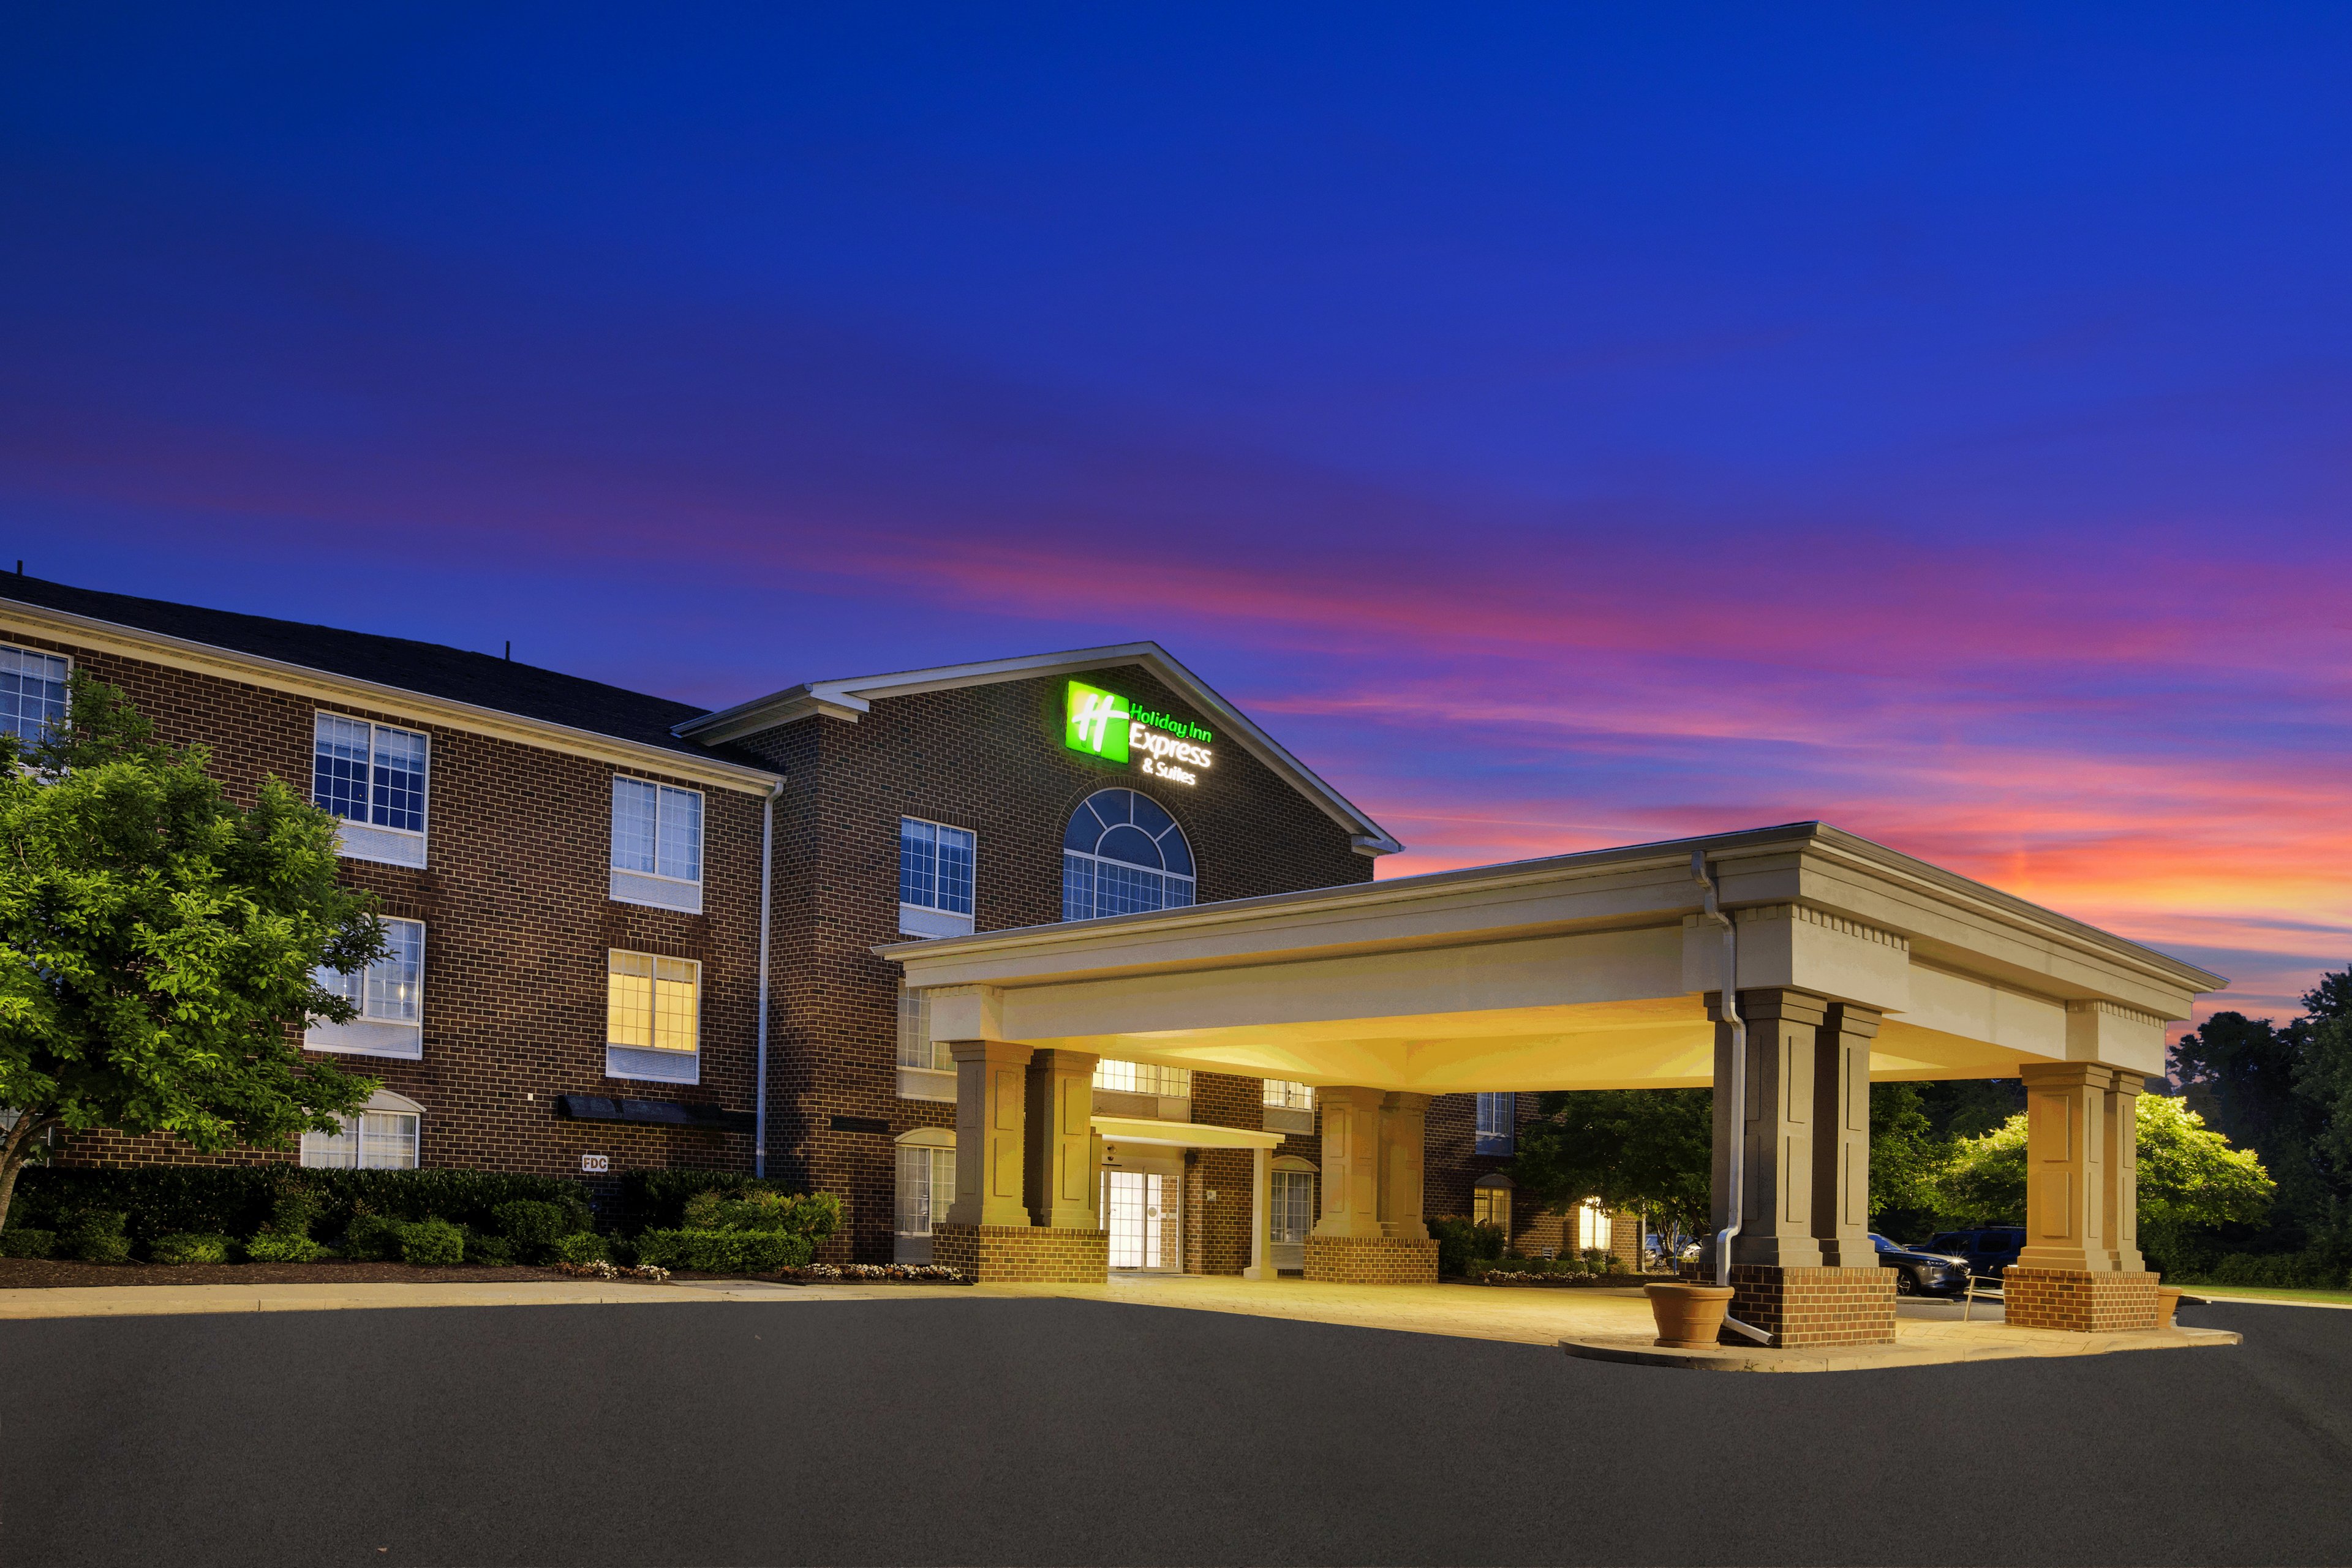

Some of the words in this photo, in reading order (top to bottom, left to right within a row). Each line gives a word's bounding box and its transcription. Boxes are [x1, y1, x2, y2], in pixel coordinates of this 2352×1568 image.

[1130, 703, 1187, 738] Holiday
[1189, 722, 1212, 743] Inn
[1129, 723, 1212, 767] Express
[1142, 758, 1153, 774] &
[1155, 761, 1196, 785] Suites
[584, 1157, 606, 1169] FDC
